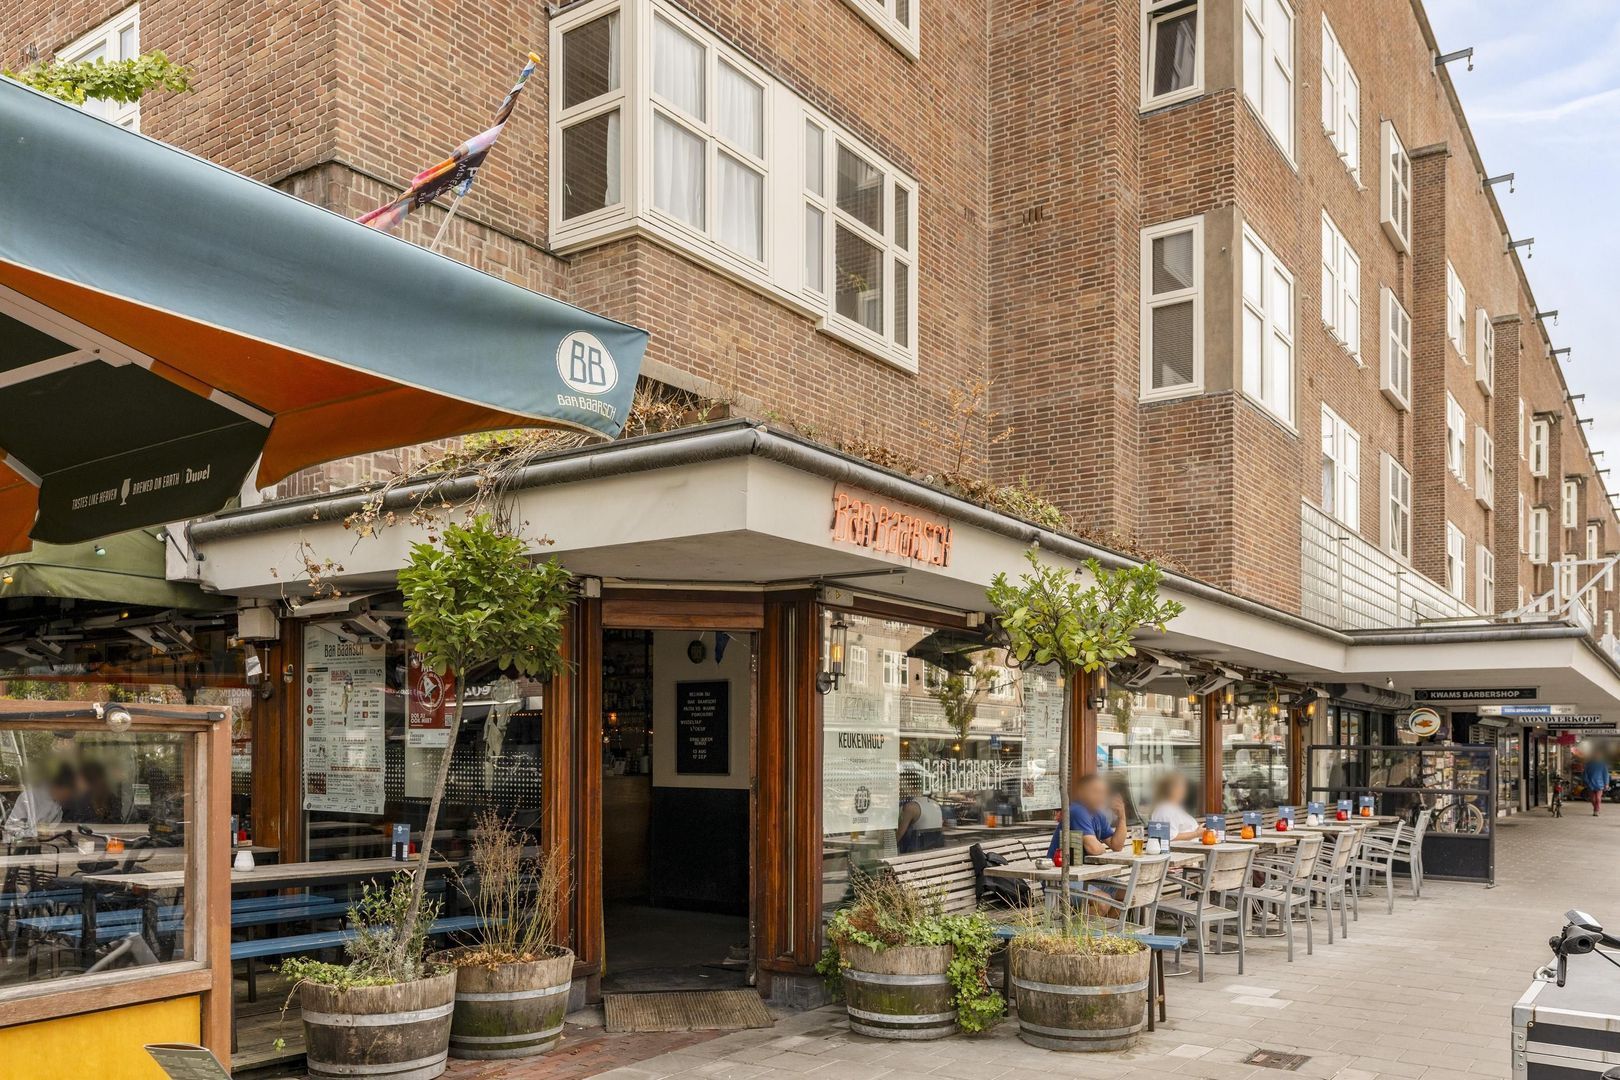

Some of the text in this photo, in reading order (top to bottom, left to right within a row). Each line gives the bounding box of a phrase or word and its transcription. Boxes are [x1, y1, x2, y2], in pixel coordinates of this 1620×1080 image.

[569, 339, 606, 386] BB
[72, 464, 211, 510] TASTES LIKE HEAVEN BREWED ON EARTH Duvel
[1430, 691, 1461, 699] KWAMS
[1462, 690, 1520, 699] BARBERSHOP
[838, 732, 885, 749] KEUKENHULP
